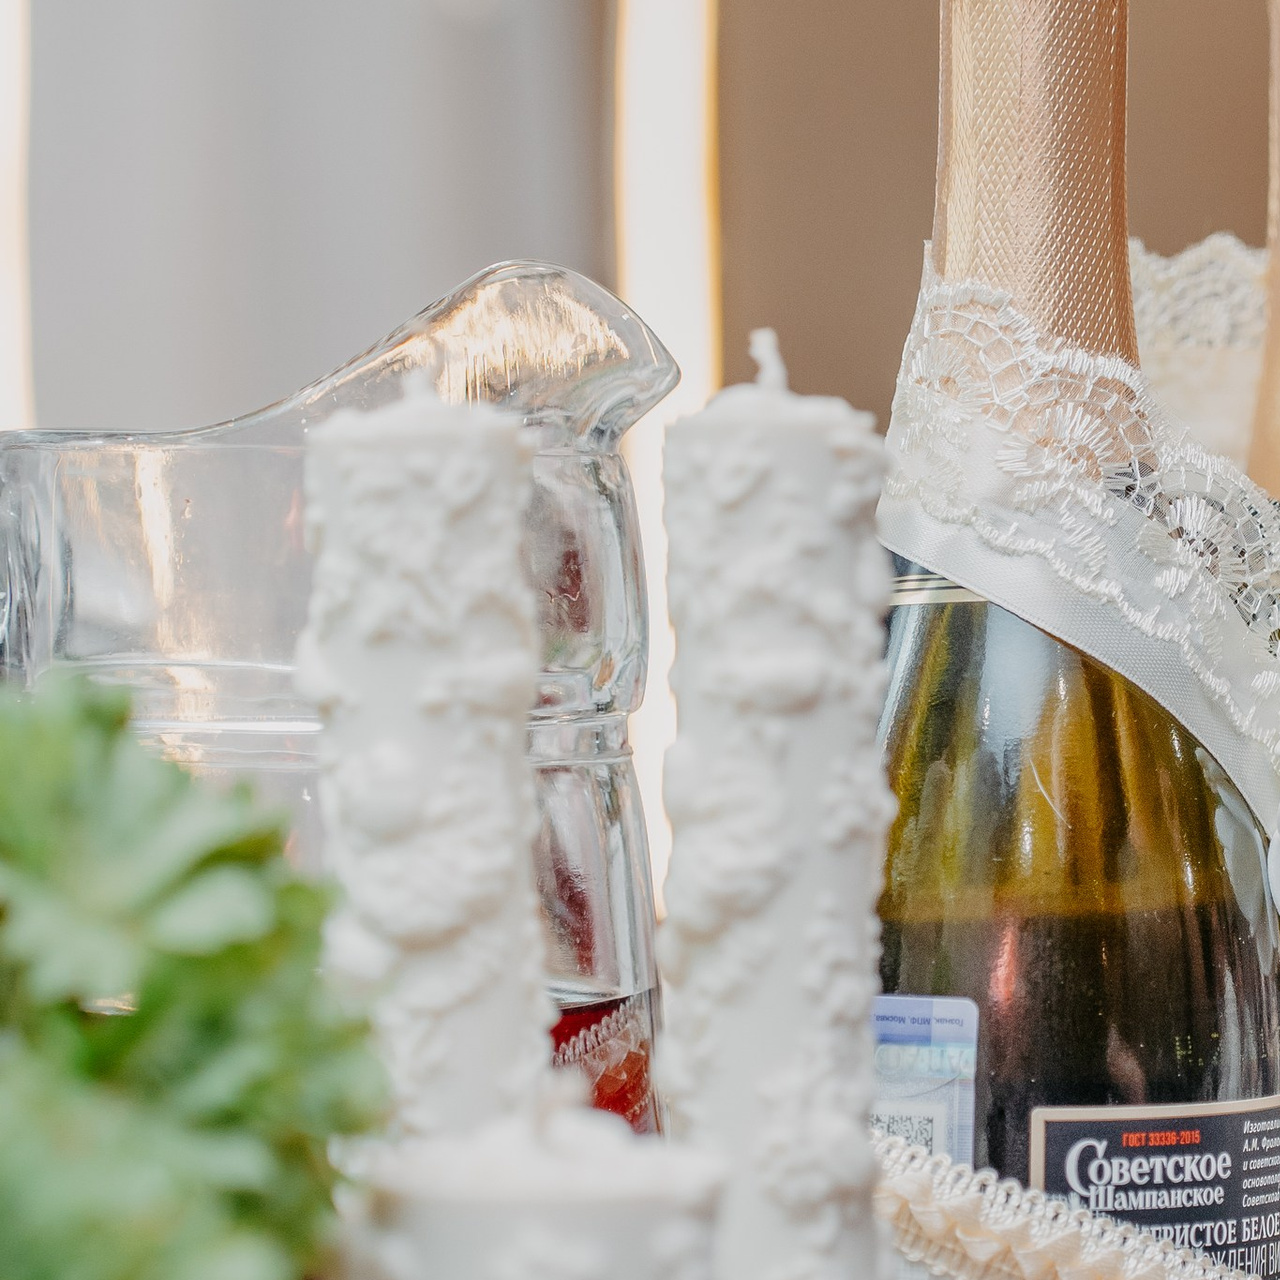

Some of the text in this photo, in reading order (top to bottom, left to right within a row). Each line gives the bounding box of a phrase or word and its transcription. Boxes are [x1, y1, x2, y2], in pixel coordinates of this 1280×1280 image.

[1121, 1129, 1201, 1148] ГОСТ 33336-2015
[1243, 1137, 1260, 1153] А.М.
[1065, 1138, 1232, 1198] Советское
[1242, 1160, 1249, 1171] и
[1089, 1184, 1225, 1212] Шампанское
[1241, 1210, 1280, 1243] БЕЛОЕ
